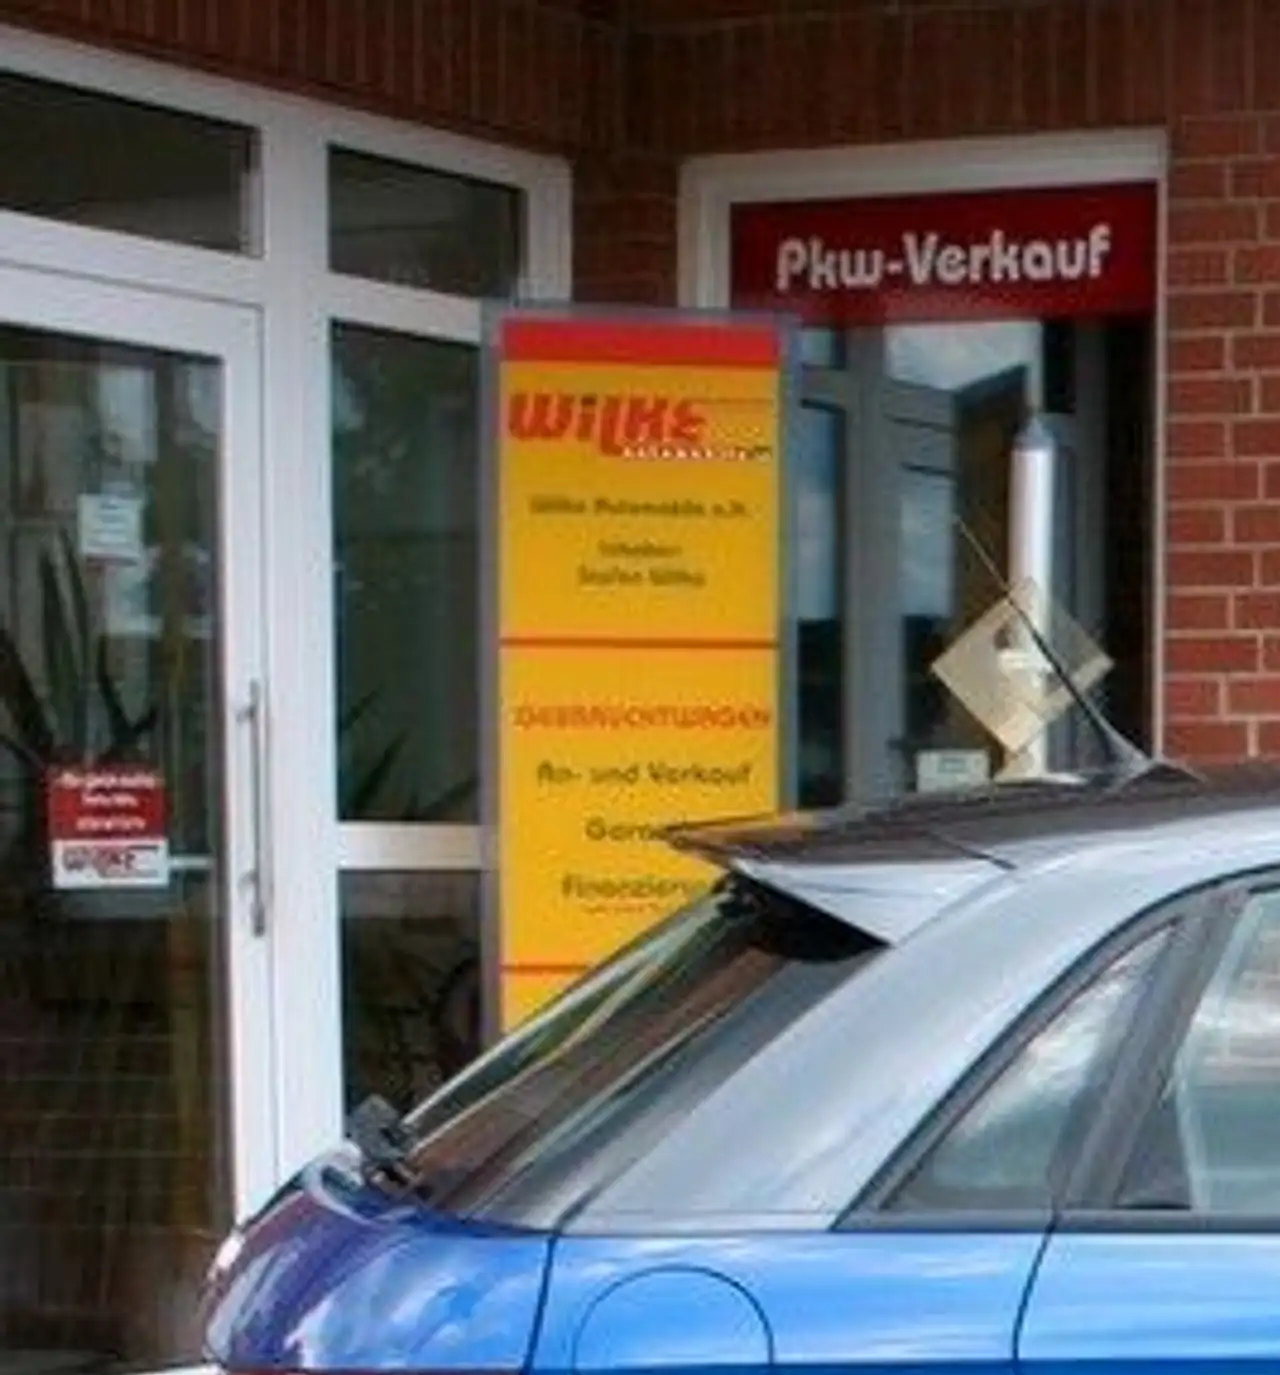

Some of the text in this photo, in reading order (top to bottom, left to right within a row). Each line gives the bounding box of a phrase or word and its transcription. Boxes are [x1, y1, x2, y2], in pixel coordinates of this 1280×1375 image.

[775, 222, 1111, 292] Pkw-Verkauf
[589, 761, 639, 785] und
[647, 761, 753, 786] Verkauf
